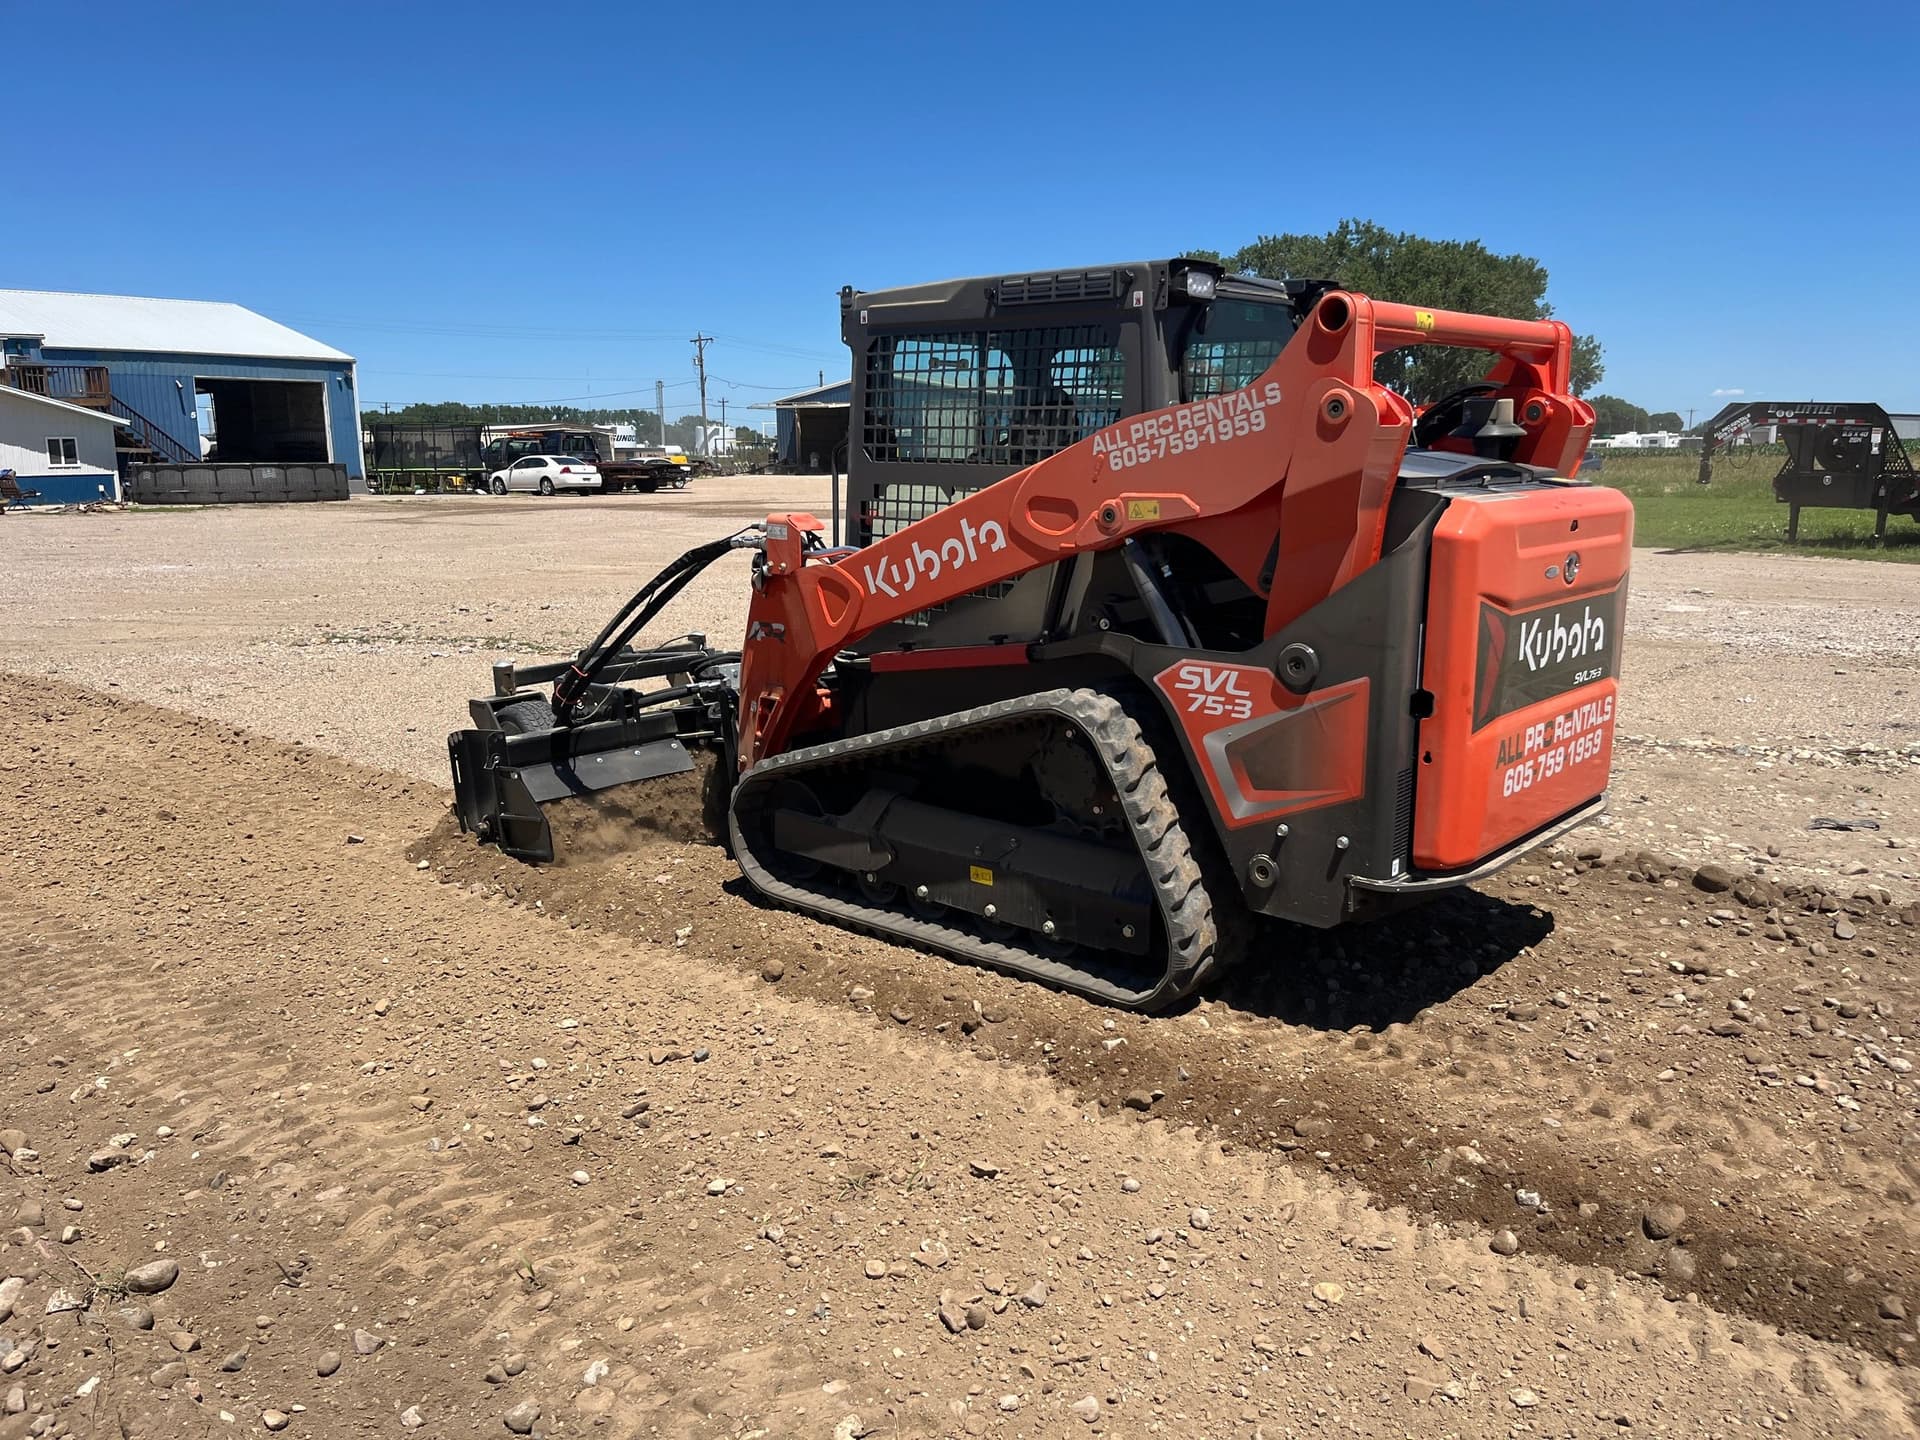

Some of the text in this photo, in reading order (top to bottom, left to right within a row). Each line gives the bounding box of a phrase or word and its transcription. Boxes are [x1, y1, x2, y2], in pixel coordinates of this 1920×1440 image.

[1092, 429, 1128, 455] ALL
[1176, 382, 1282, 433] RENTALS
[1109, 409, 1266, 471] 605-759-1959
[863, 518, 1007, 598] Kubota
[1518, 606, 1605, 671] Kubota
[1174, 665, 1250, 697] SVL
[1187, 693, 1253, 719] 75-3
[1496, 733, 1523, 769] ALL
[1553, 696, 1613, 743] RENTALS
[1503, 728, 1602, 797] 605-759-1959
